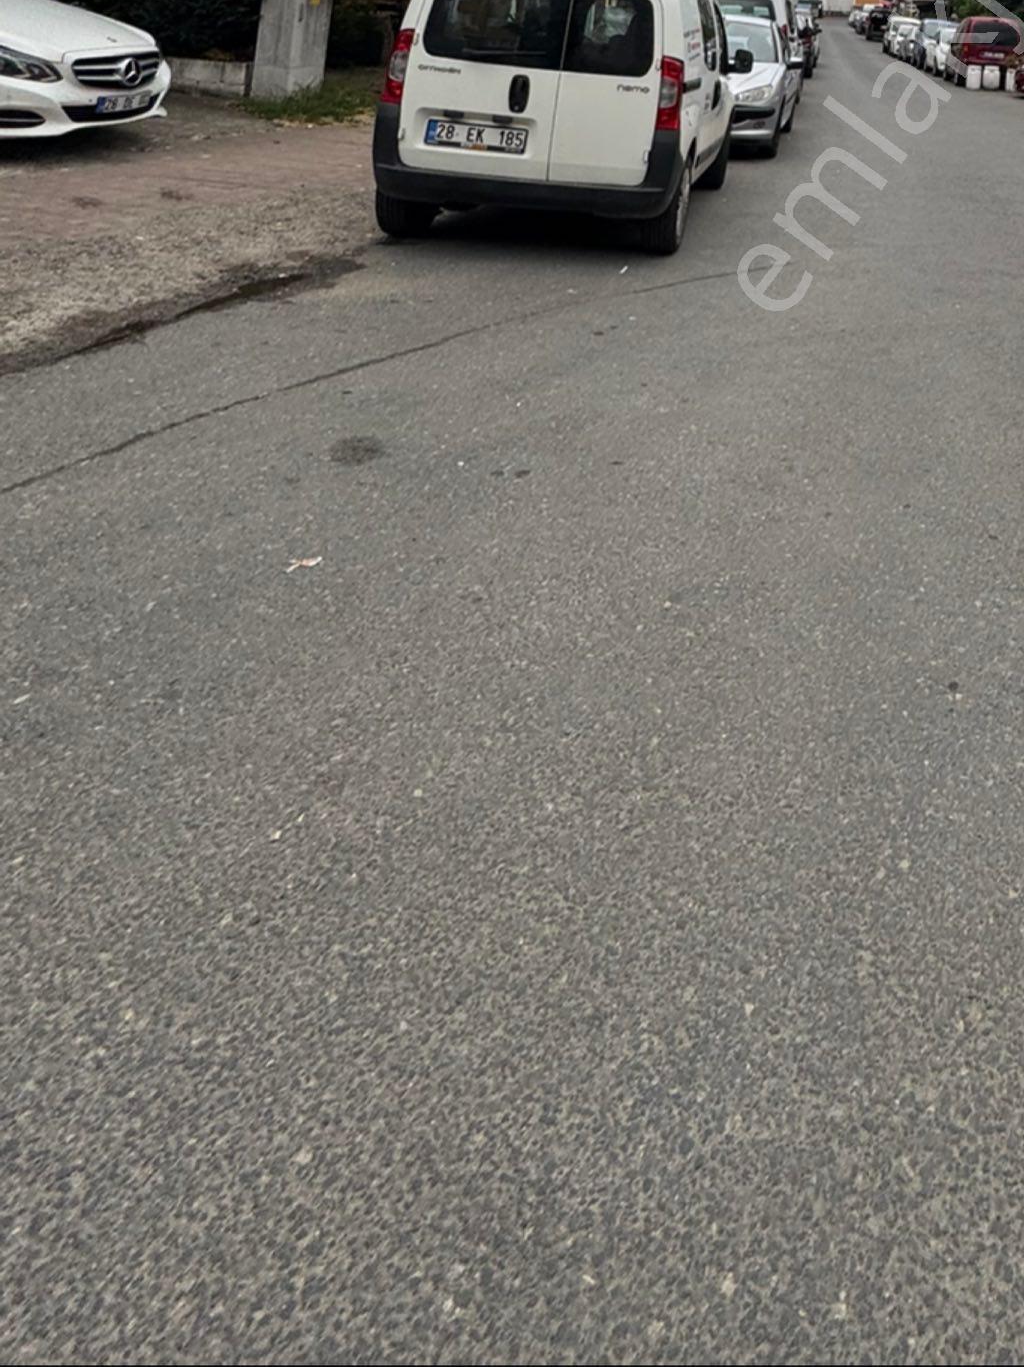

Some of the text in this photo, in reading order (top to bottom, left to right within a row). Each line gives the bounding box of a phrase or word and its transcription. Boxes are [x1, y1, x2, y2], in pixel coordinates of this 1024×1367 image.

[436, 124, 455, 140] 28
[466, 127, 486, 144] EK
[499, 130, 525, 147] 185
